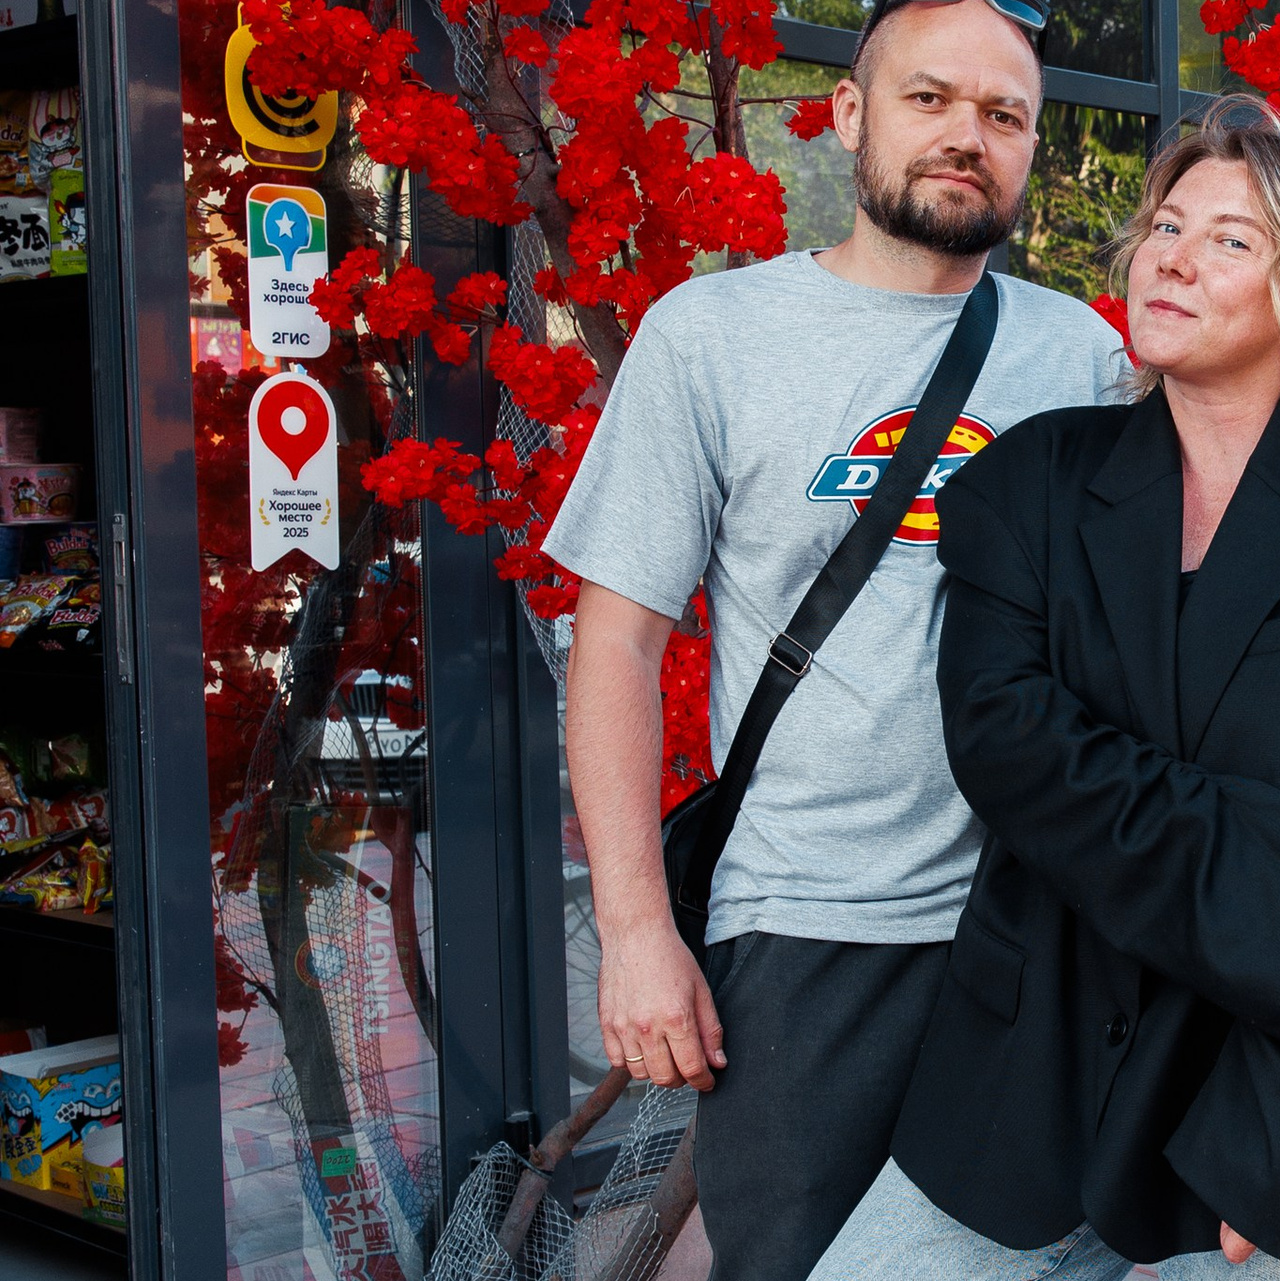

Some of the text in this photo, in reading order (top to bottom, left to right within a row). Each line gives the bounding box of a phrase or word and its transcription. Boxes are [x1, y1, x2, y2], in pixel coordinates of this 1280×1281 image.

[271, 278, 309, 293] Здесь
[272, 331, 311, 346] 2ГИС
[272, 488, 318, 497] Яндекс Карты
[269, 500, 322, 513] Хорошее
[278, 514, 313, 522] место
[283, 527, 309, 538] 2025
